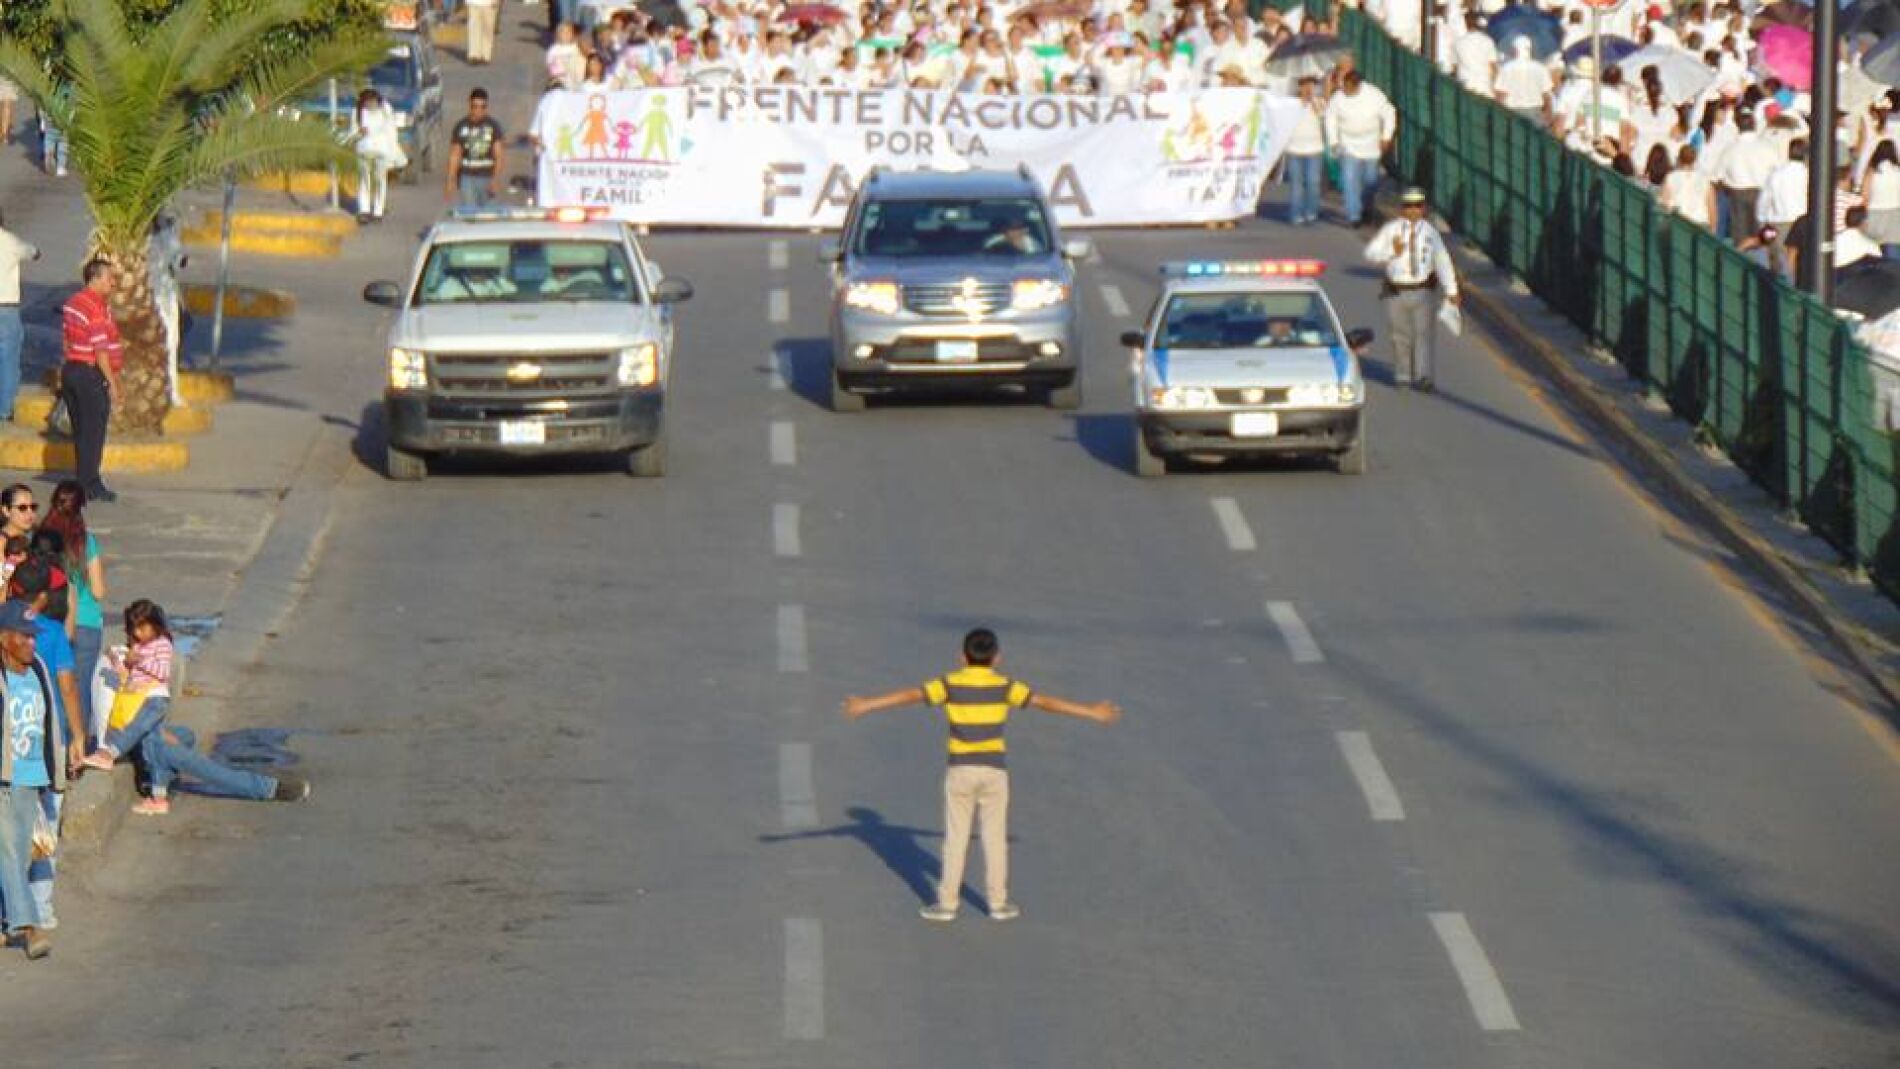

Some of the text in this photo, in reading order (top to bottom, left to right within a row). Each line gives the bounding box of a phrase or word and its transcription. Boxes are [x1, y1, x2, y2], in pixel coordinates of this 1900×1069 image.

[686, 86, 1169, 130] FRENTE NACIONAL
[865, 129, 989, 157] POR LA
[581, 186, 655, 205] FAMIL
